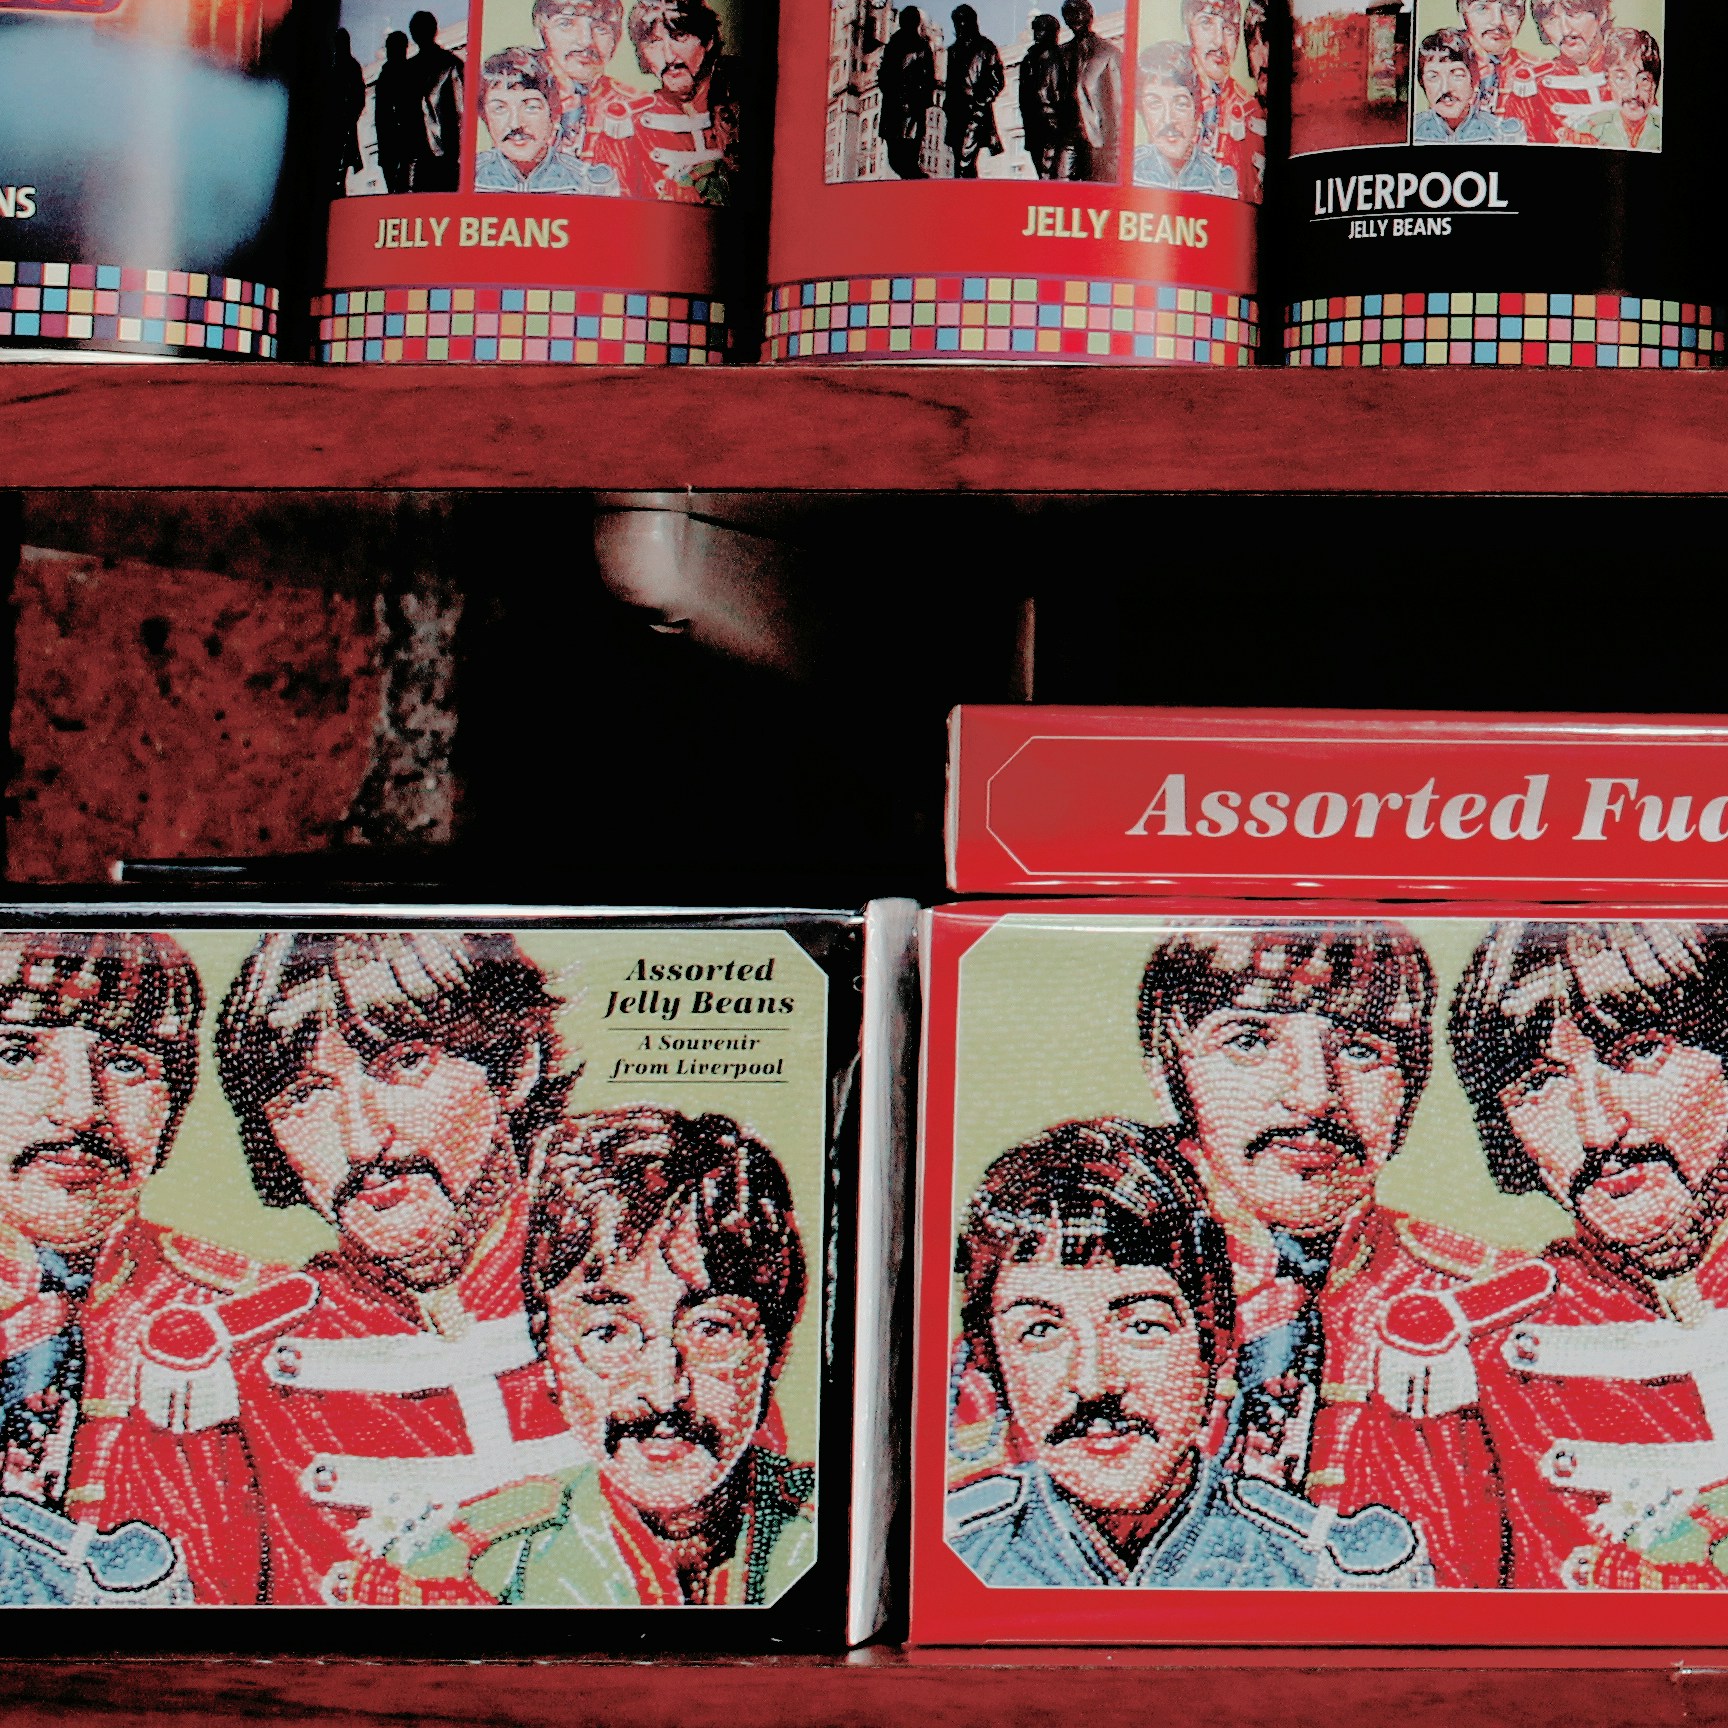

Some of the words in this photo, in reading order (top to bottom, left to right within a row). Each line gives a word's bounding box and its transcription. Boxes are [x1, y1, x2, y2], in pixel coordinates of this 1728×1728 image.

[1315, 172, 1508, 215] LIVERPOOL
[374, 217, 450, 250] JELLY
[459, 216, 569, 249] BEANS
[1022, 206, 1110, 238] JELLY
[1118, 211, 1208, 249] BEANS
[1348, 220, 1388, 239] JELLY
[1393, 217, 1452, 237] BEANS
[1124, 773, 1548, 842] Assorted
[625, 958, 775, 981] Assorted
[602, 990, 680, 1021] Jelly
[692, 991, 794, 1014] Beans
[638, 1035, 651, 1050] A
[659, 1035, 760, 1051] Souvenir
[610, 1058, 668, 1078] from
[677, 1058, 783, 1079] Liverpool
